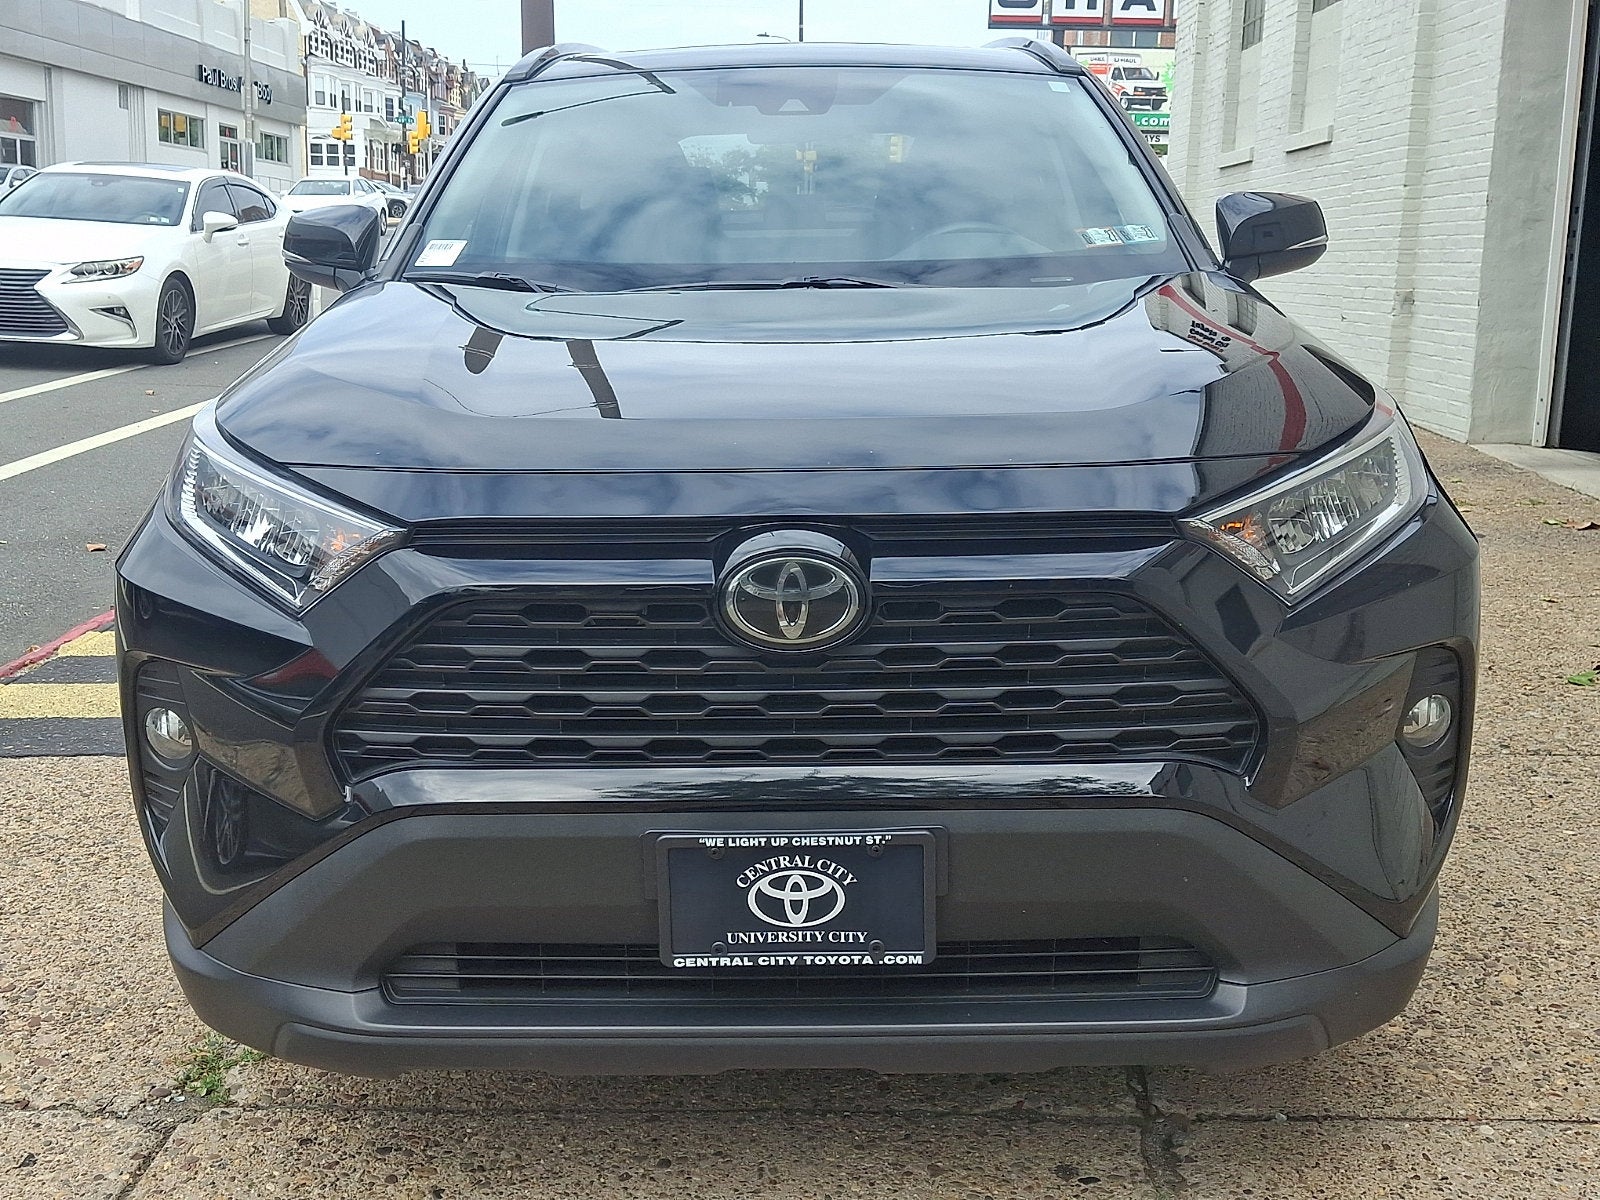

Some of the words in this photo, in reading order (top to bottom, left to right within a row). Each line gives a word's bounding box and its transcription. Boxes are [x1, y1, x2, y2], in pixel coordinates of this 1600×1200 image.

[201, 64, 219, 86] Paul
[220, 70, 239, 91] Bros.
[728, 836, 767, 847] LIGHT
[771, 837, 789, 847] UP
[791, 836, 862, 847] CHESTNUT
[736, 854, 815, 888] CENTRAL
[816, 858, 858, 887] CITY
[726, 931, 826, 945] UNIVERSITY
[828, 931, 868, 943] CITY
[673, 955, 753, 968] CENTRAL
[757, 955, 797, 966] CITY
[802, 955, 874, 966] TOYOTA
[878, 954, 923, 966] .COM
